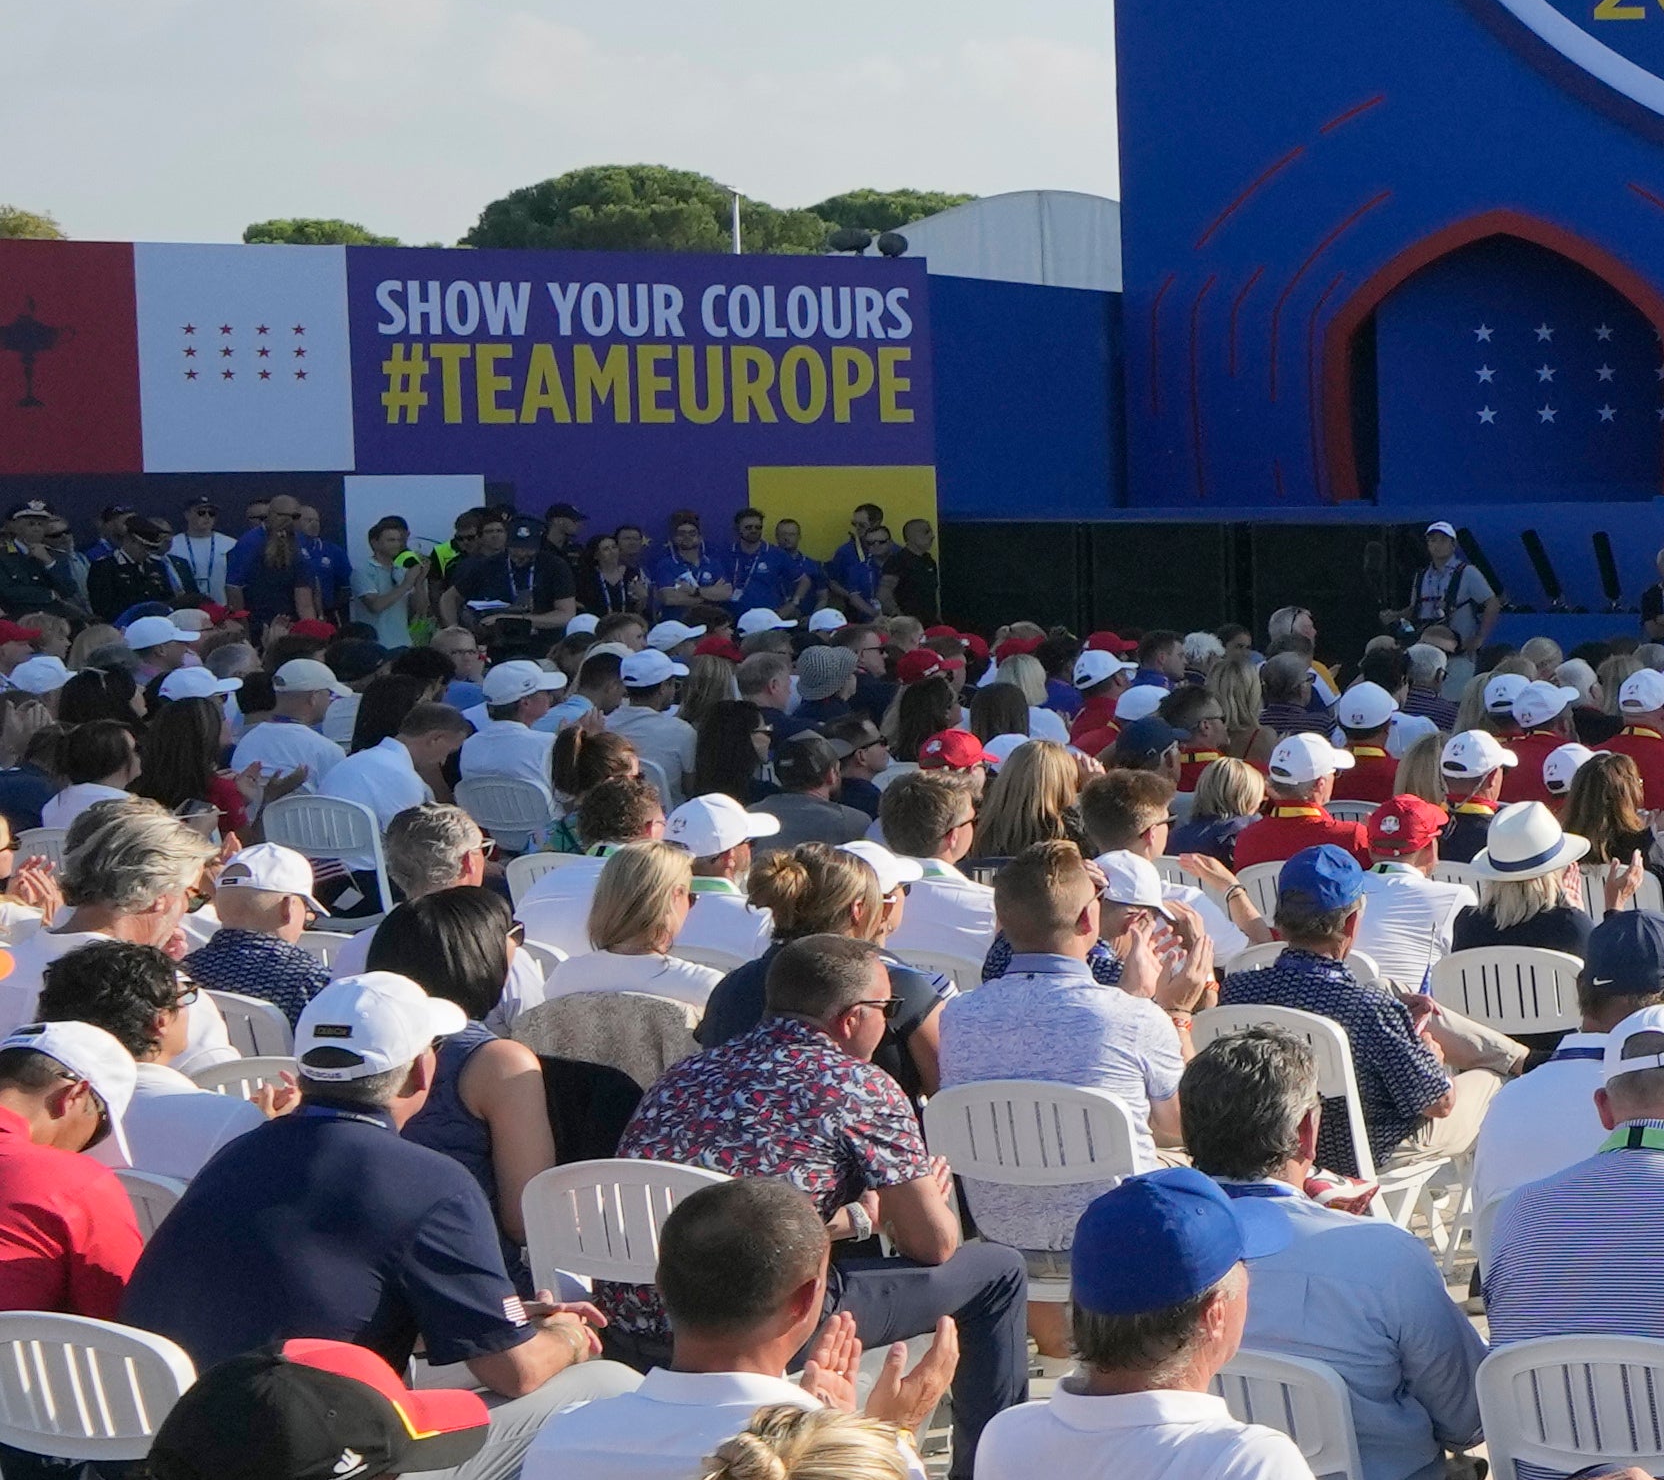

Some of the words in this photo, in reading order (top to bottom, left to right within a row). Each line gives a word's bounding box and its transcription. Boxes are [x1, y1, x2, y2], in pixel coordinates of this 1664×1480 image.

[375, 279, 531, 337] SHOW
[547, 281, 685, 338] YOUR
[700, 283, 914, 341] COLOURS
[380, 343, 915, 426] #TEAMEUROPE
